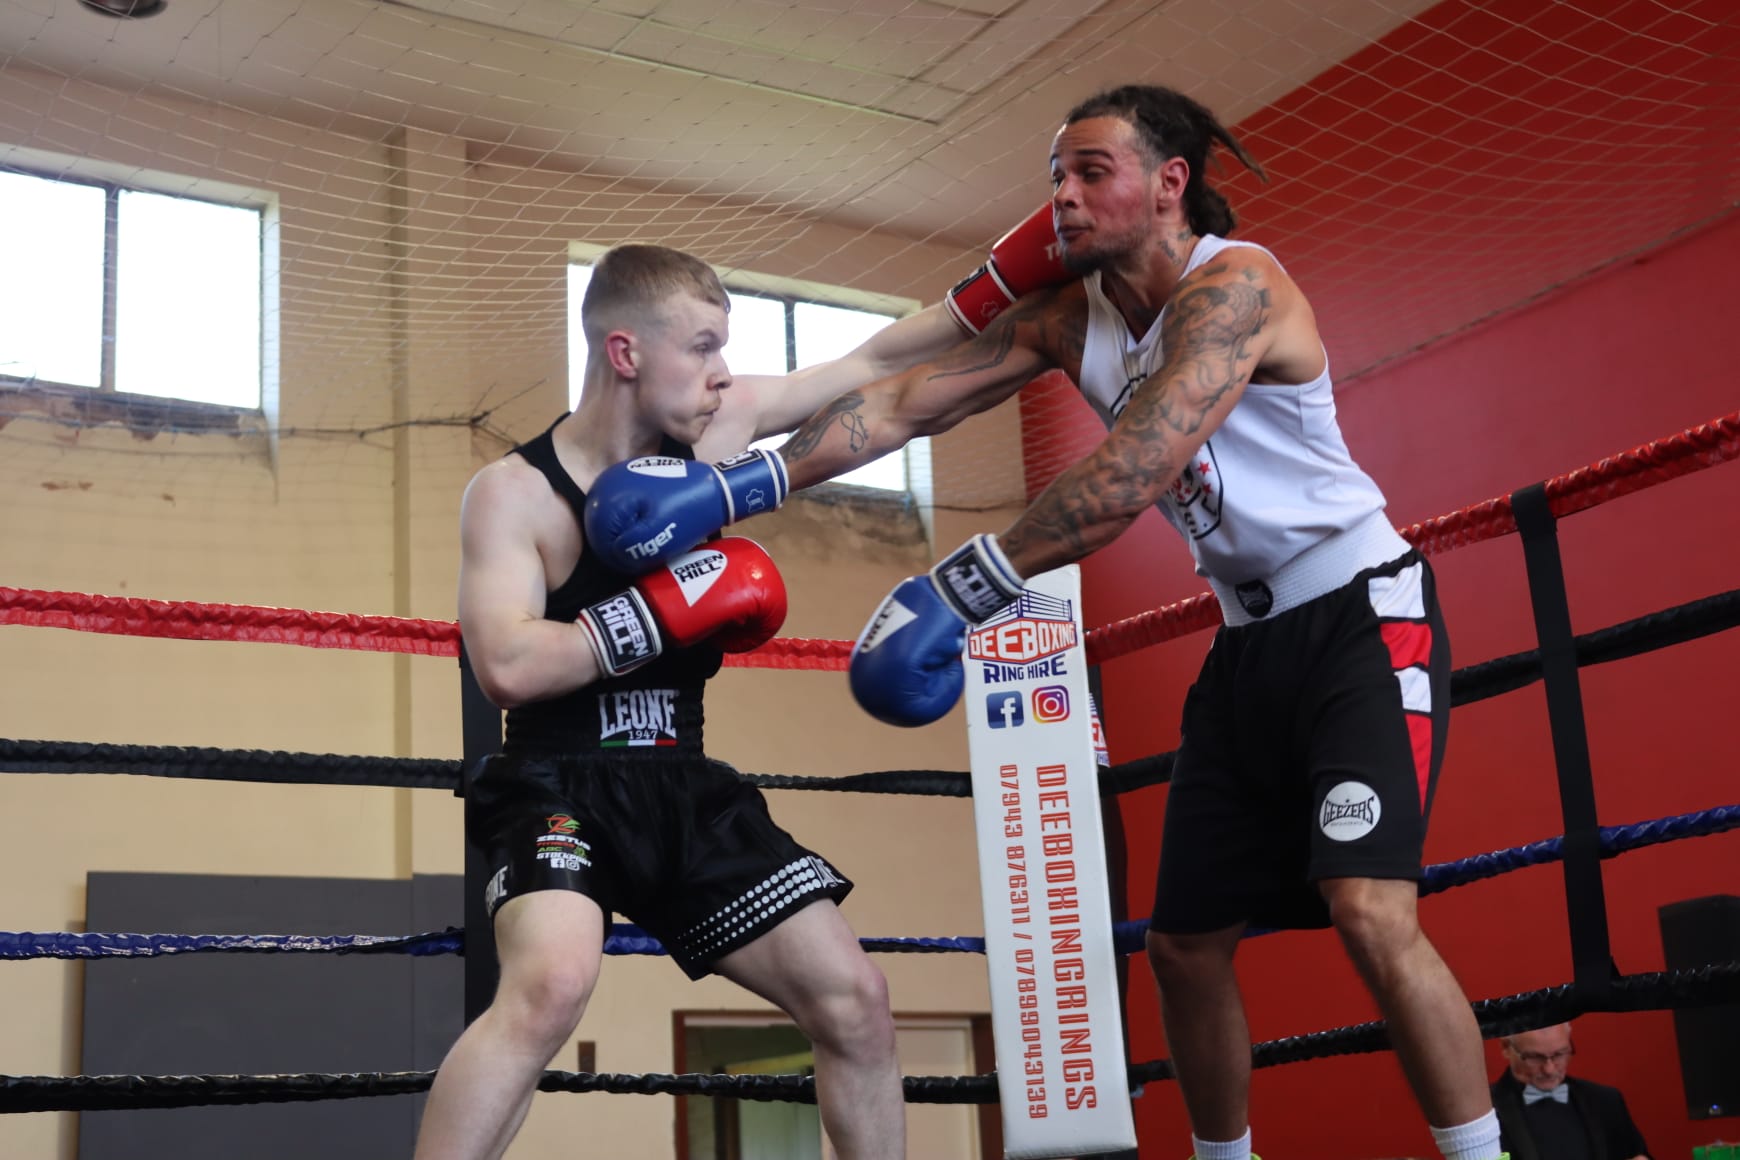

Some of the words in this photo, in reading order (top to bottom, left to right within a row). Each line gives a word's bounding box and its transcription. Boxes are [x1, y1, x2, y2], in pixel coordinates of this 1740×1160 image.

[626, 522, 677, 560] Tiger
[674, 553, 724, 576] GREEN
[679, 563, 722, 583] HILL
[598, 602, 629, 656] HILL
[612, 596, 648, 657] GREEN
[970, 620, 1075, 660] DEEBOXING
[983, 662, 1025, 684] RING
[1028, 653, 1068, 680] HIRE
[598, 689, 677, 740] LEONE
[628, 730, 658, 740] 1947
[999, 763, 1024, 839] 07943
[1323, 795, 1375, 828] GEEZERS
[1006, 845, 1031, 924] 876311
[1036, 763, 1098, 1111] DEEBOXINGRINGS
[1015, 948, 1048, 1120] 07899043139
